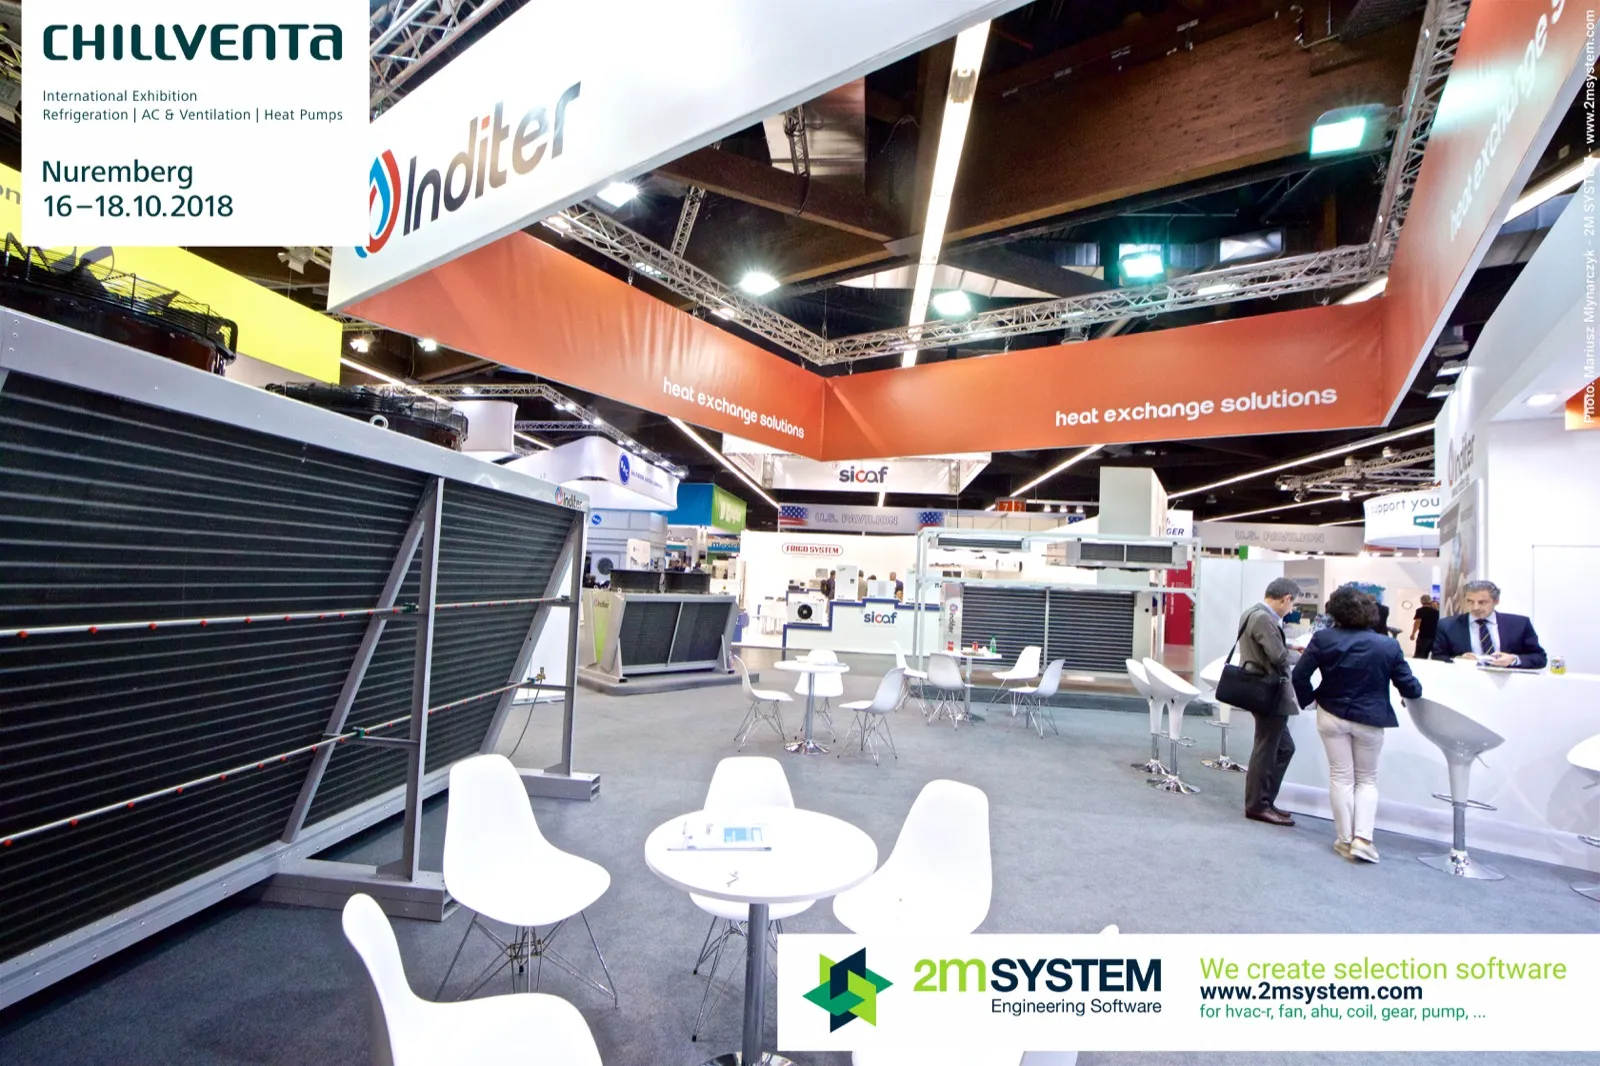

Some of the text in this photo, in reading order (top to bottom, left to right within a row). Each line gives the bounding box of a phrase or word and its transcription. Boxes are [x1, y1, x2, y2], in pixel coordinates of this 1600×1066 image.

[1473, 13, 1549, 191] exchange
[402, 80, 582, 237] Inditer
[663, 376, 805, 439] heat exchange solutions
[1055, 388, 1338, 427] heat exchange solutions
[838, 465, 889, 484] sicaf
[815, 511, 899, 525] U.S. PAVILION
[1263, 532, 1325, 543] PAVILION
[786, 545, 839, 555] FRIGO SYSTEM
[863, 611, 898, 624] sicaf
